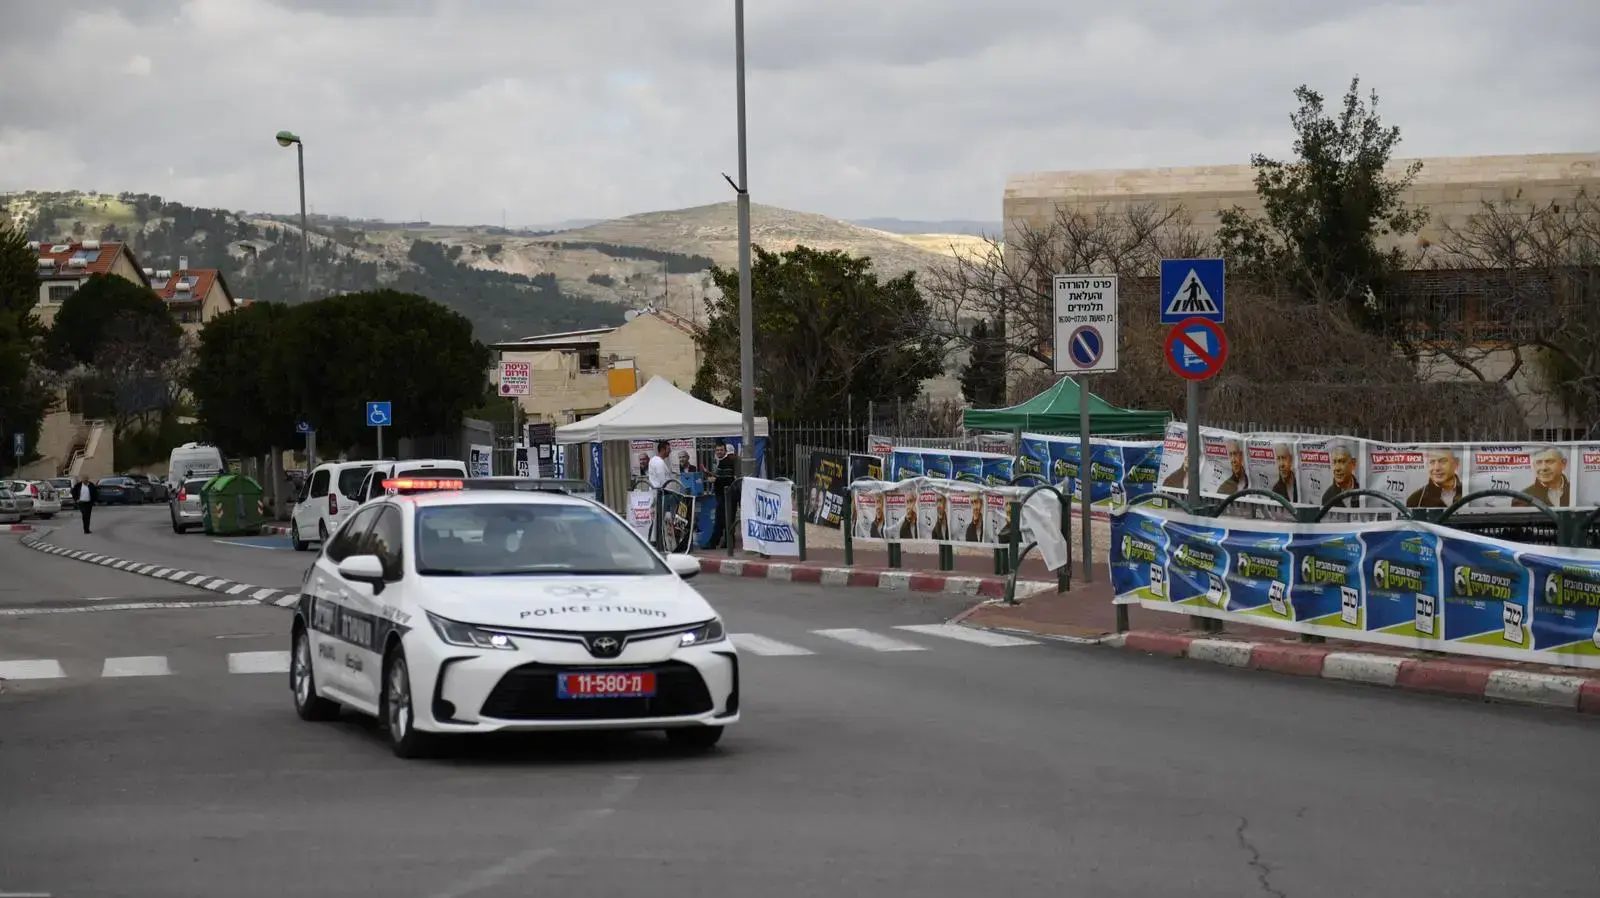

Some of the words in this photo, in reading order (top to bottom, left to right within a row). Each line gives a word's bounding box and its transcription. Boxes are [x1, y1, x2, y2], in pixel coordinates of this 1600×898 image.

[1060, 280, 1090, 289] להורדה
[1093, 280, 1112, 288] פרט
[1069, 291, 1103, 300] והעלאת
[1068, 302, 1103, 312] תלמידים
[1386, 476, 1404, 492] מחל
[758, 494, 779, 521] אמת
[1470, 572, 1490, 582] מהבית
[1491, 575, 1511, 586] יוצאים
[1564, 579, 1583, 590] מהבית
[1472, 582, 1512, 600] ומכריעים
[520, 606, 591, 618] POLICE
[598, 606, 666, 618] משטרה
[1505, 606, 1522, 627] טב
